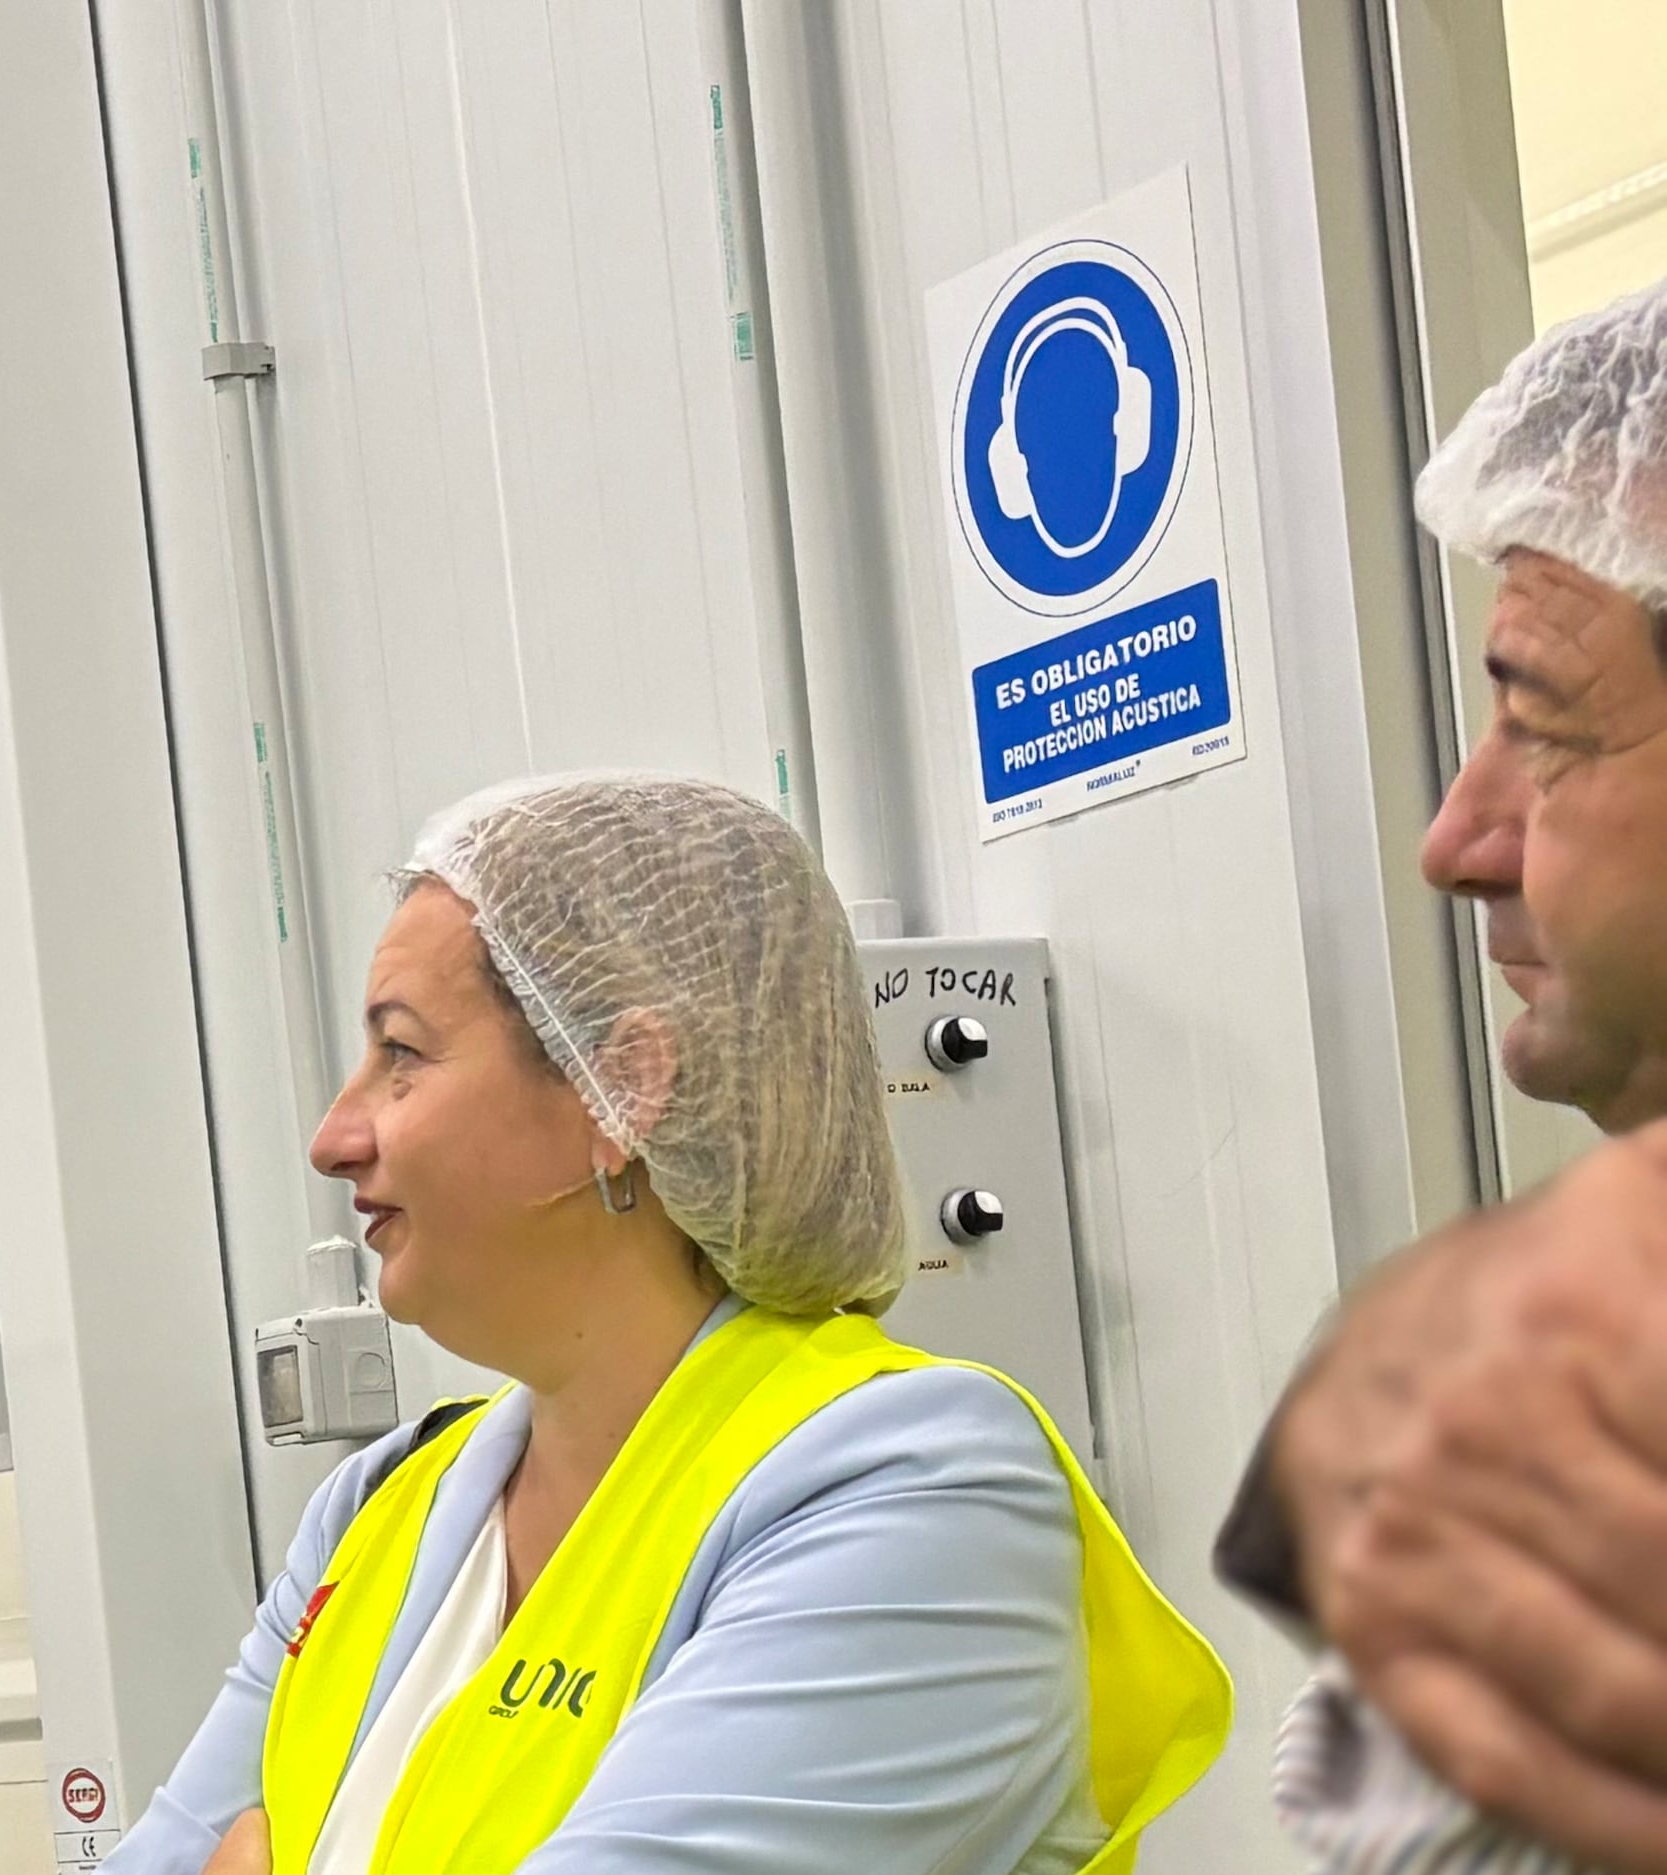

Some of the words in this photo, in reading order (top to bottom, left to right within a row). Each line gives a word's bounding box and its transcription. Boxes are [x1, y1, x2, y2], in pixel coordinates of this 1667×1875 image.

[996, 678, 1026, 709] ES
[1031, 615, 1197, 695] OBLIGATORIO
[1003, 715, 1107, 774] PROTECCION
[1112, 684, 1201, 736] ACUSTICA
[1050, 700, 1071, 727] EL
[1075, 684, 1110, 716] USO
[1115, 673, 1141, 702] DE
[875, 968, 908, 1008] NO
[925, 967, 1016, 1006] TOCAR
